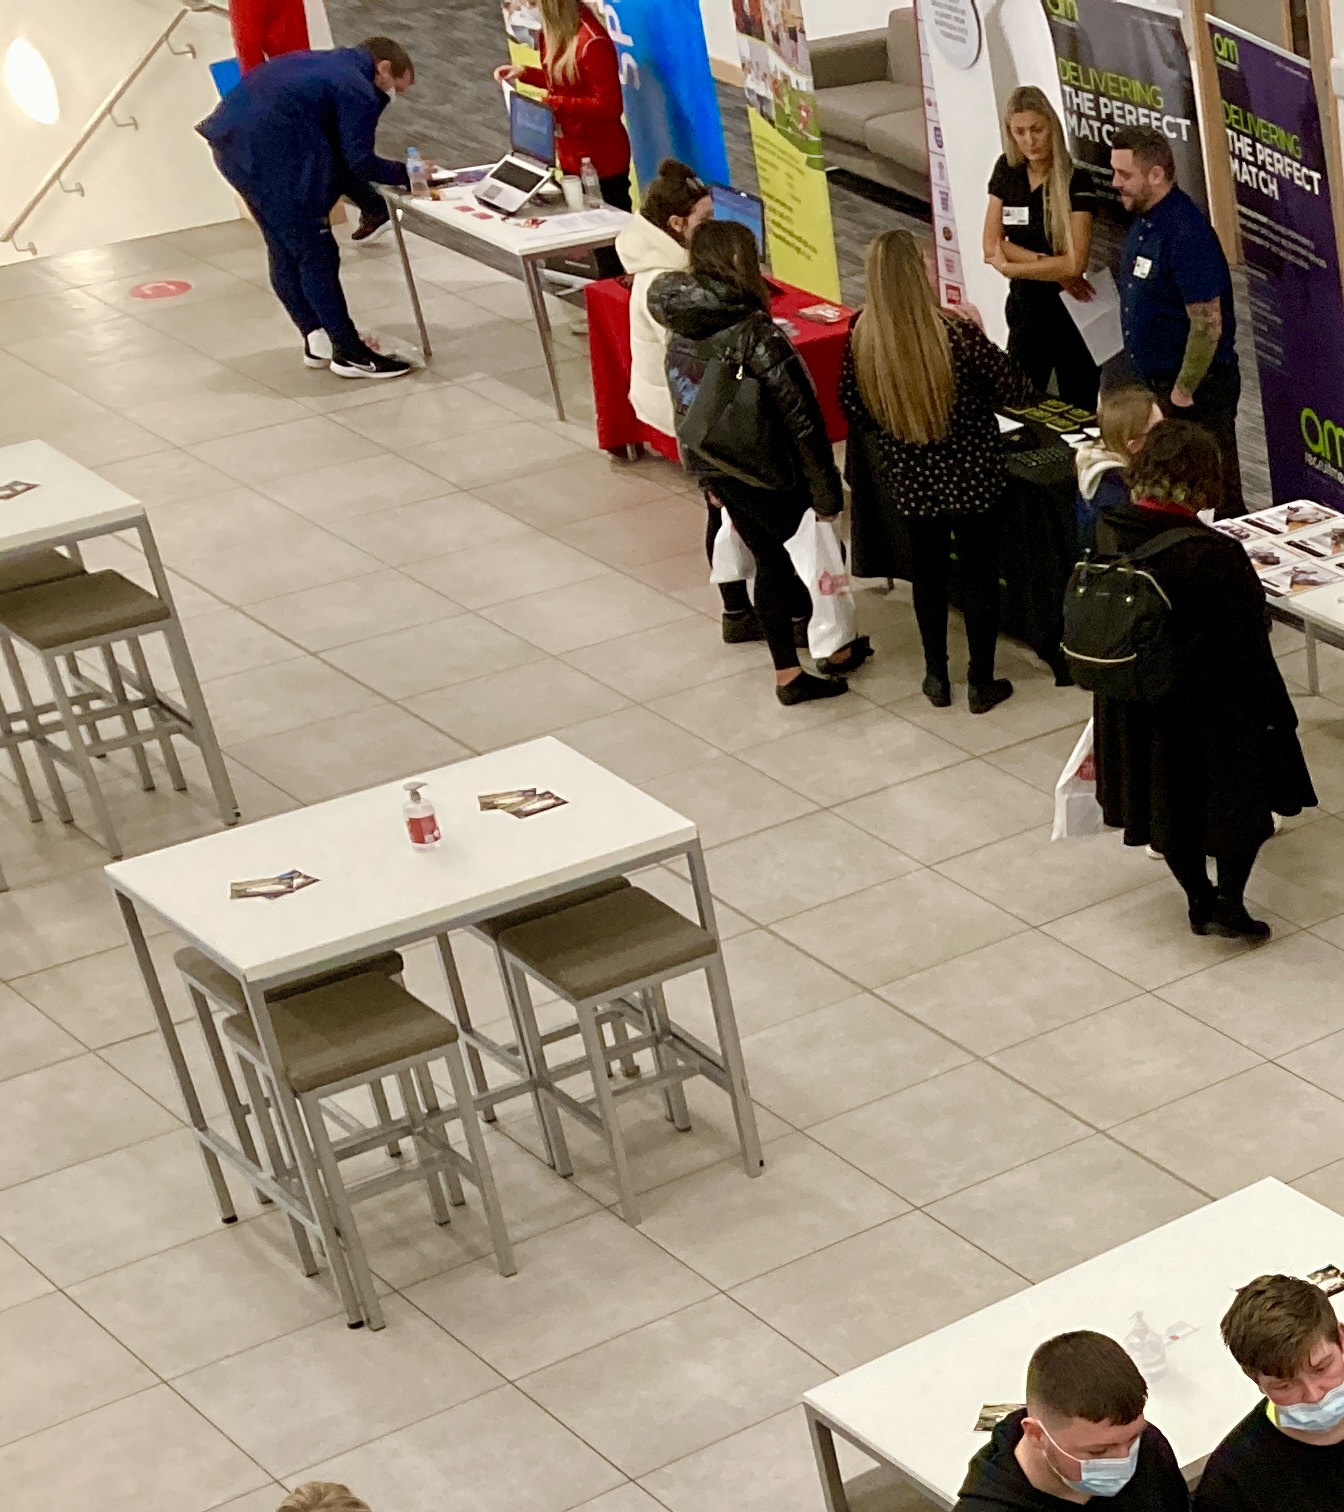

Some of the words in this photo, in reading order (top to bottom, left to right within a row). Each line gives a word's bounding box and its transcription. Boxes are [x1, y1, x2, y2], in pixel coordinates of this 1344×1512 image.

[1058, 56, 1164, 110] DELIVERING
[1062, 86, 1096, 116] THE
[1099, 96, 1191, 143] PERFECT
[1064, 111, 1122, 149] MATC
[1223, 101, 1302, 159] DELIVERING
[1227, 128, 1255, 162] THE
[1256, 137, 1322, 196] PERFECT
[1230, 159, 1280, 201] MATCH
